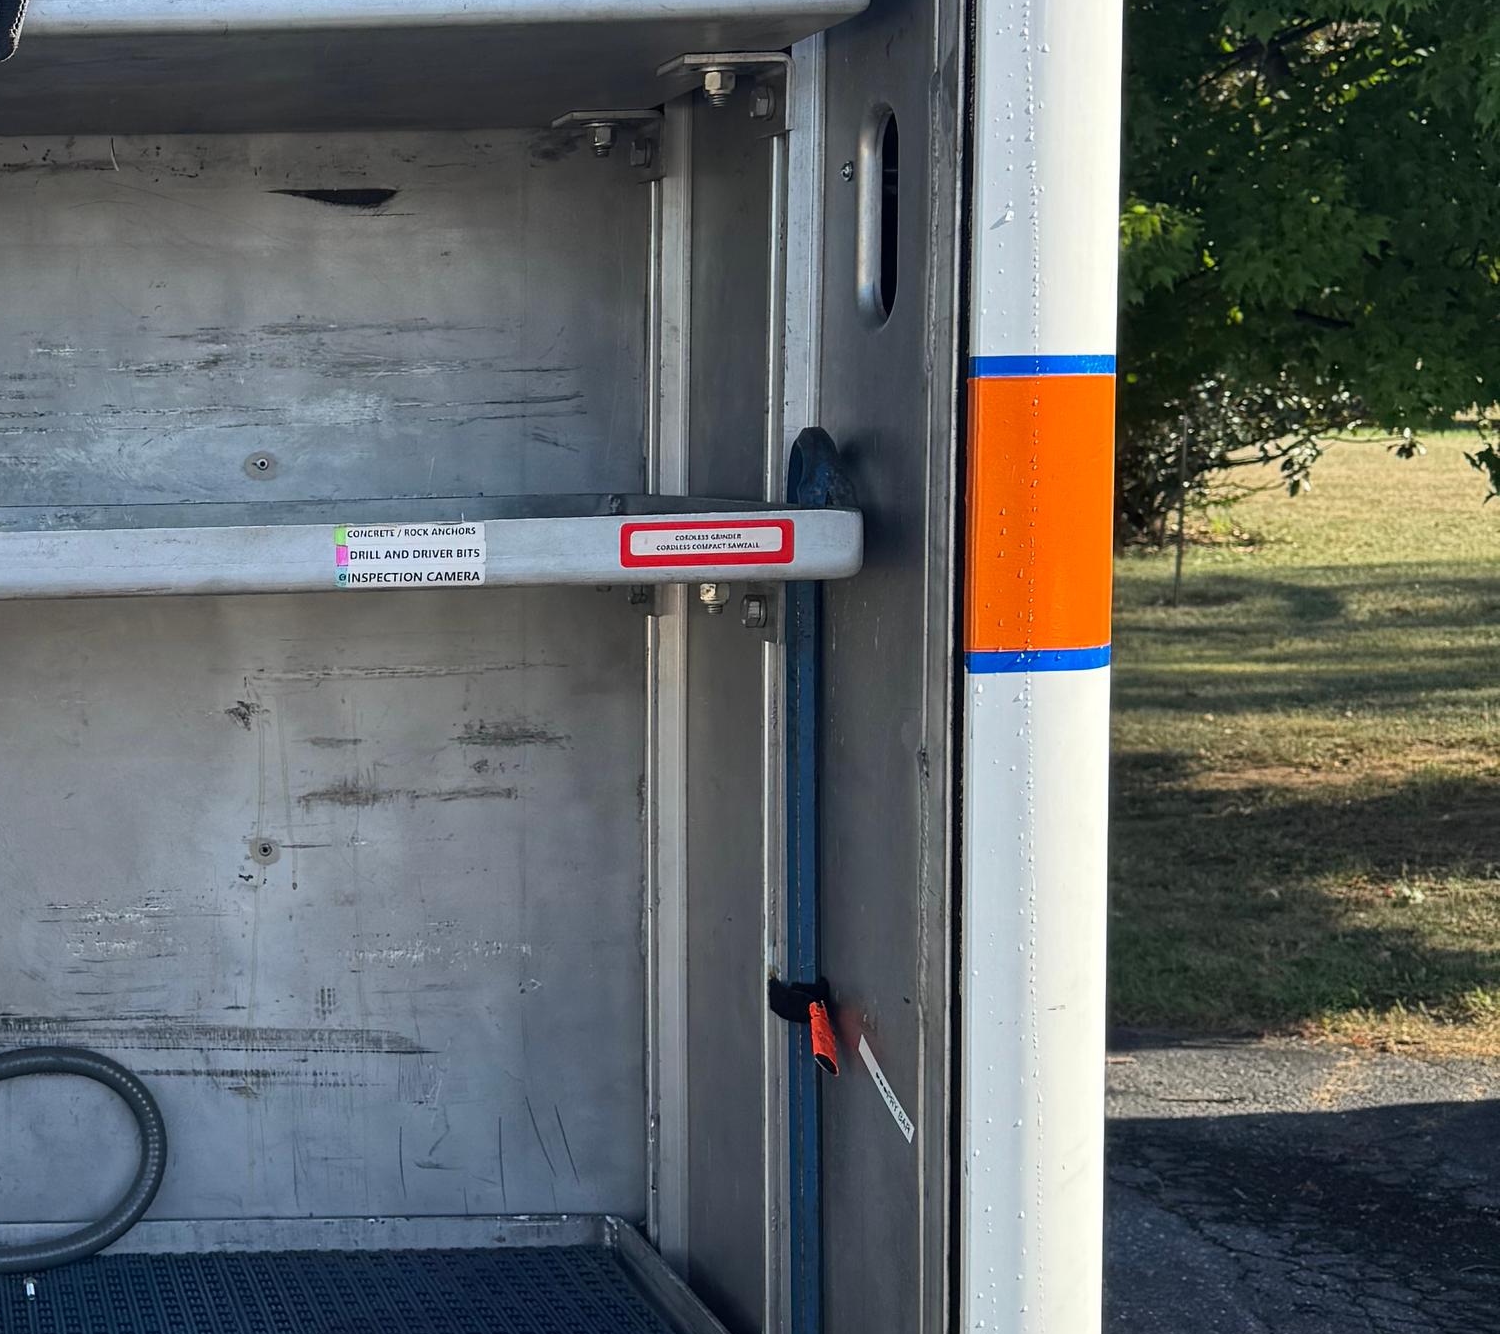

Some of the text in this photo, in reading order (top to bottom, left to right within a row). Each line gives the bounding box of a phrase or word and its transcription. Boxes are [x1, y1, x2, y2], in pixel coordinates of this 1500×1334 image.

[347, 529, 395, 539] CONCRETE
[404, 528, 429, 538] ROCK
[431, 526, 477, 537] ANCHORS
[350, 548, 480, 561] DRILL AND DRIVER BITS
[347, 571, 481, 584] INSPECTION CAMERA
